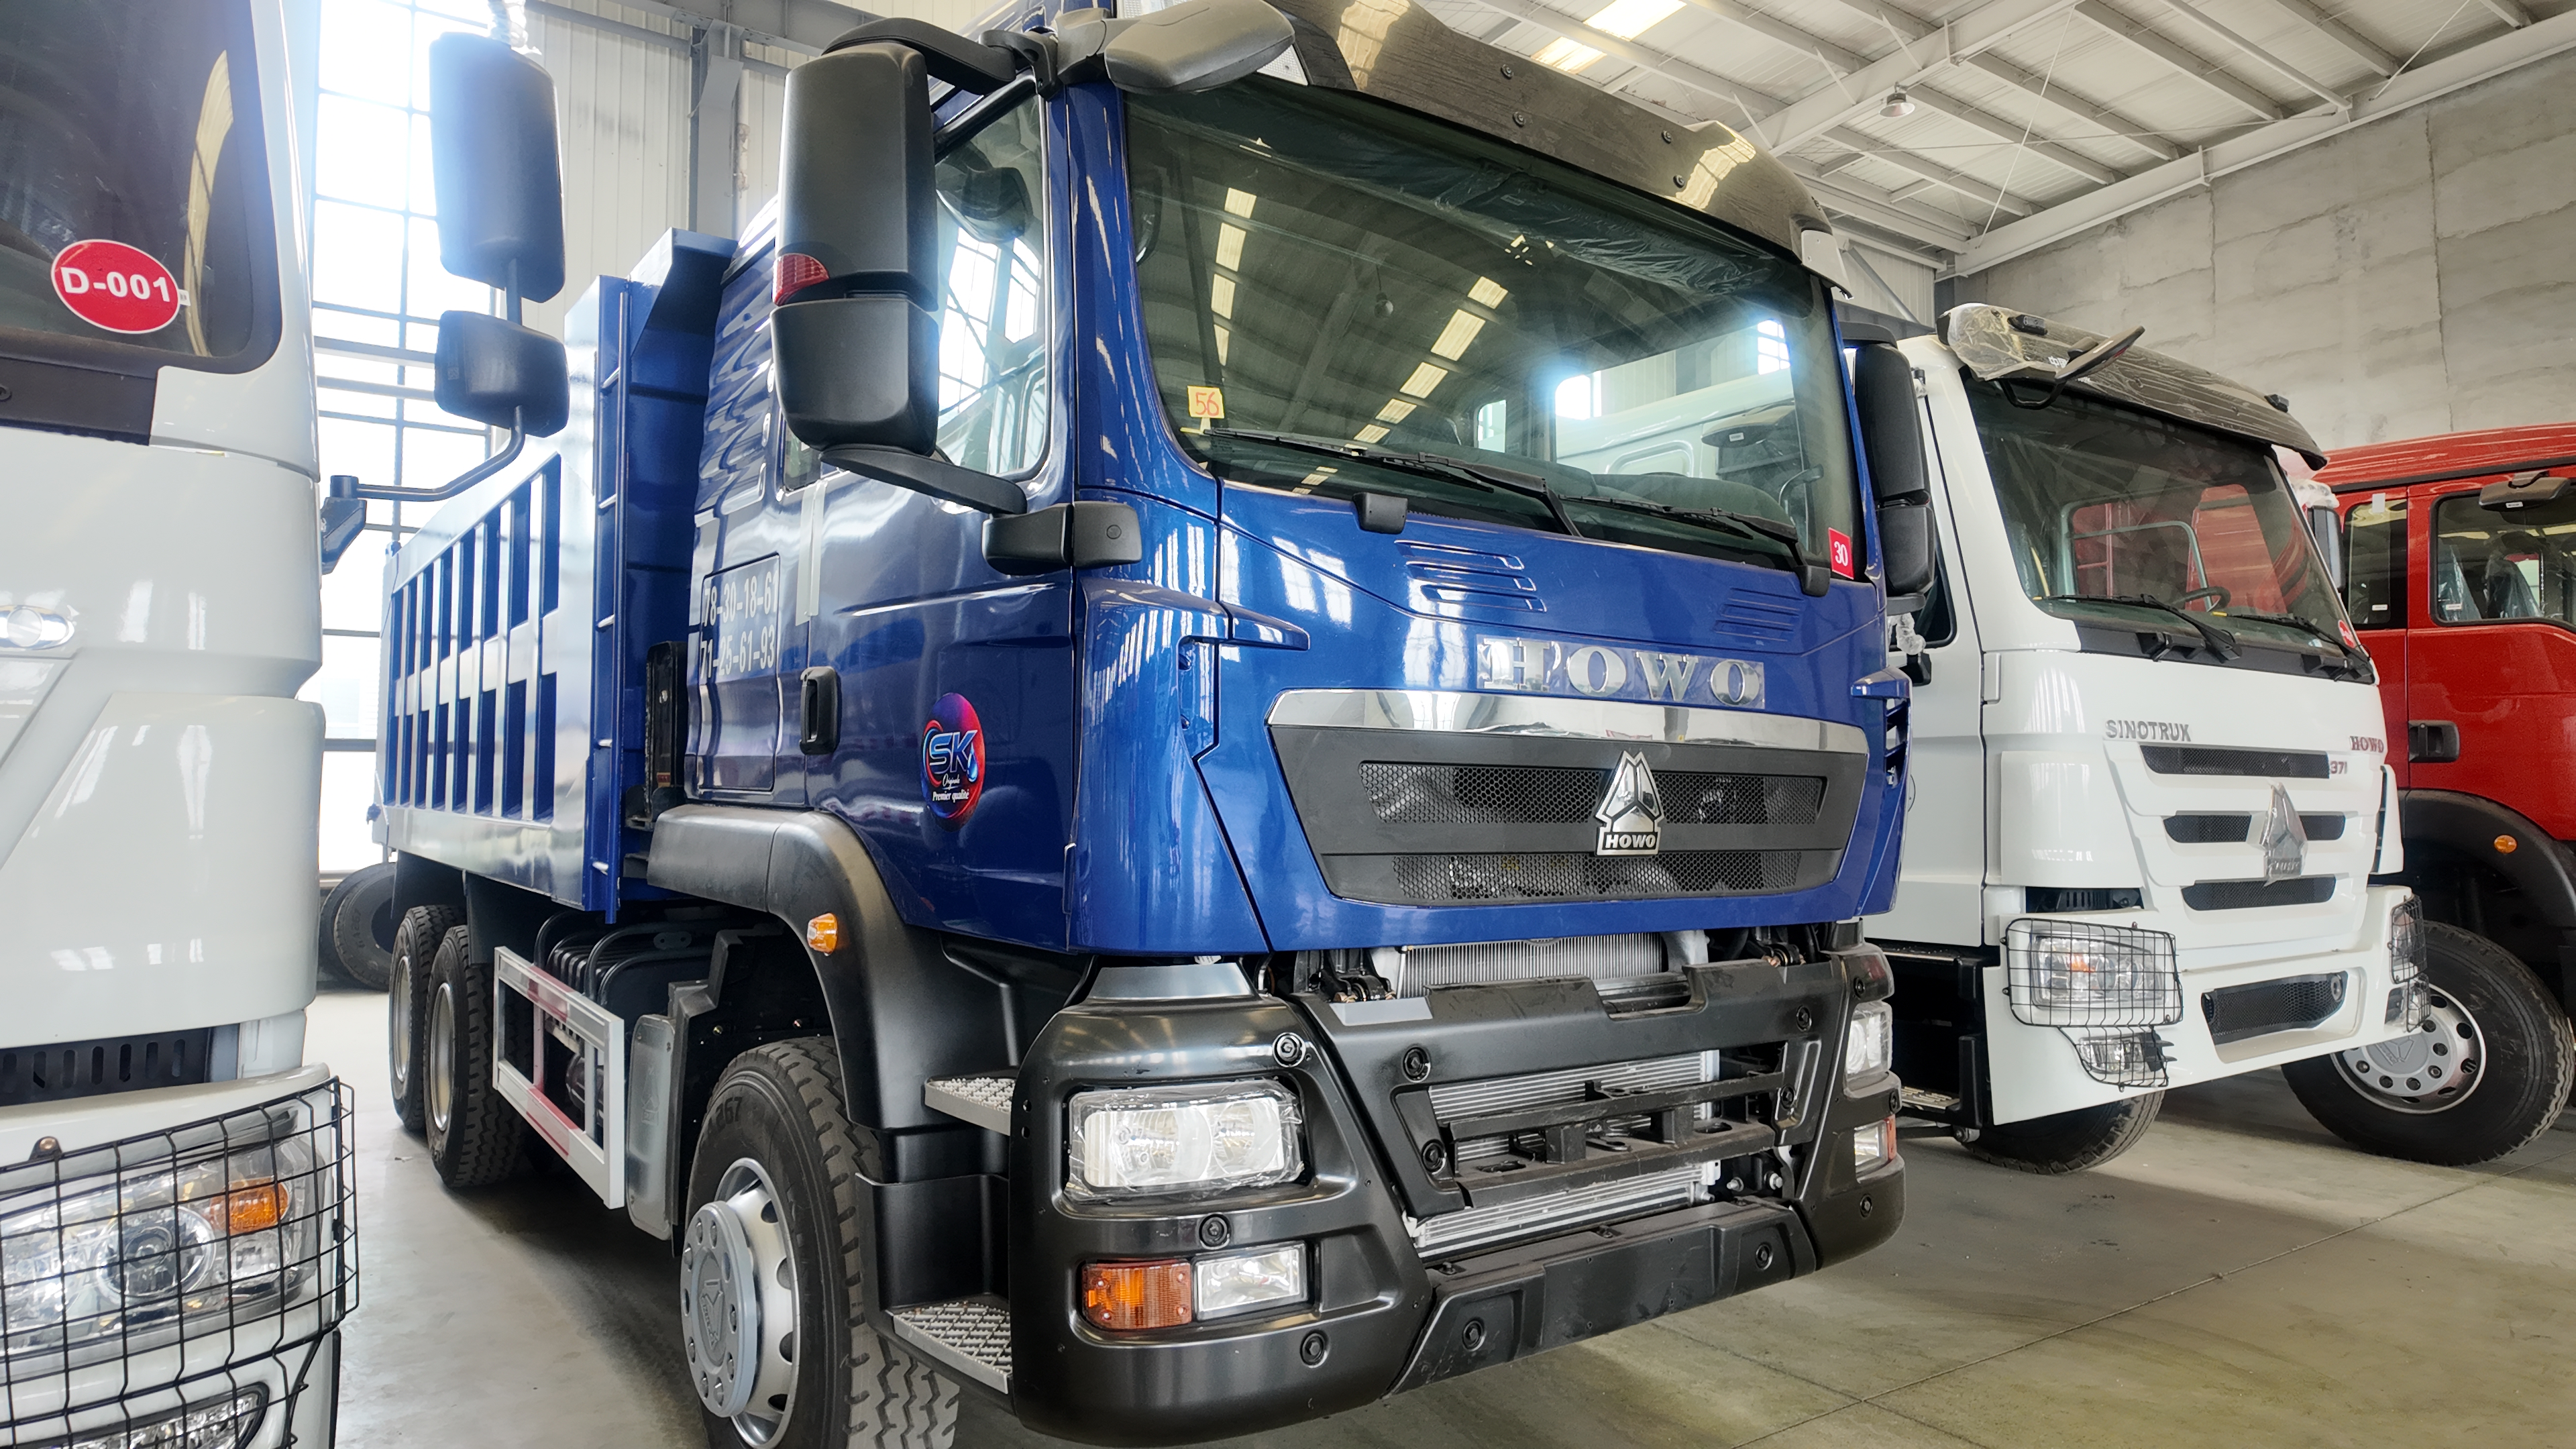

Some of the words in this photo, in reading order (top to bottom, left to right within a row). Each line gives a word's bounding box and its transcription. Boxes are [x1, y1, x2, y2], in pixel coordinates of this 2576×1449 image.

[60, 267, 170, 303] D-001
[1195, 392, 1219, 416] 56
[1834, 541, 1848, 567] 30
[704, 570, 778, 627] 78-30-18-61
[700, 625, 775, 679] 71-25-61-93
[1484, 637, 1762, 707] HOWO
[2105, 719, 2192, 742] SINOTRUK
[929, 730, 978, 775] SK
[2351, 736, 2385, 753] HOWO
[932, 790, 951, 802] Premier
[1605, 834, 1656, 849] HOWO
